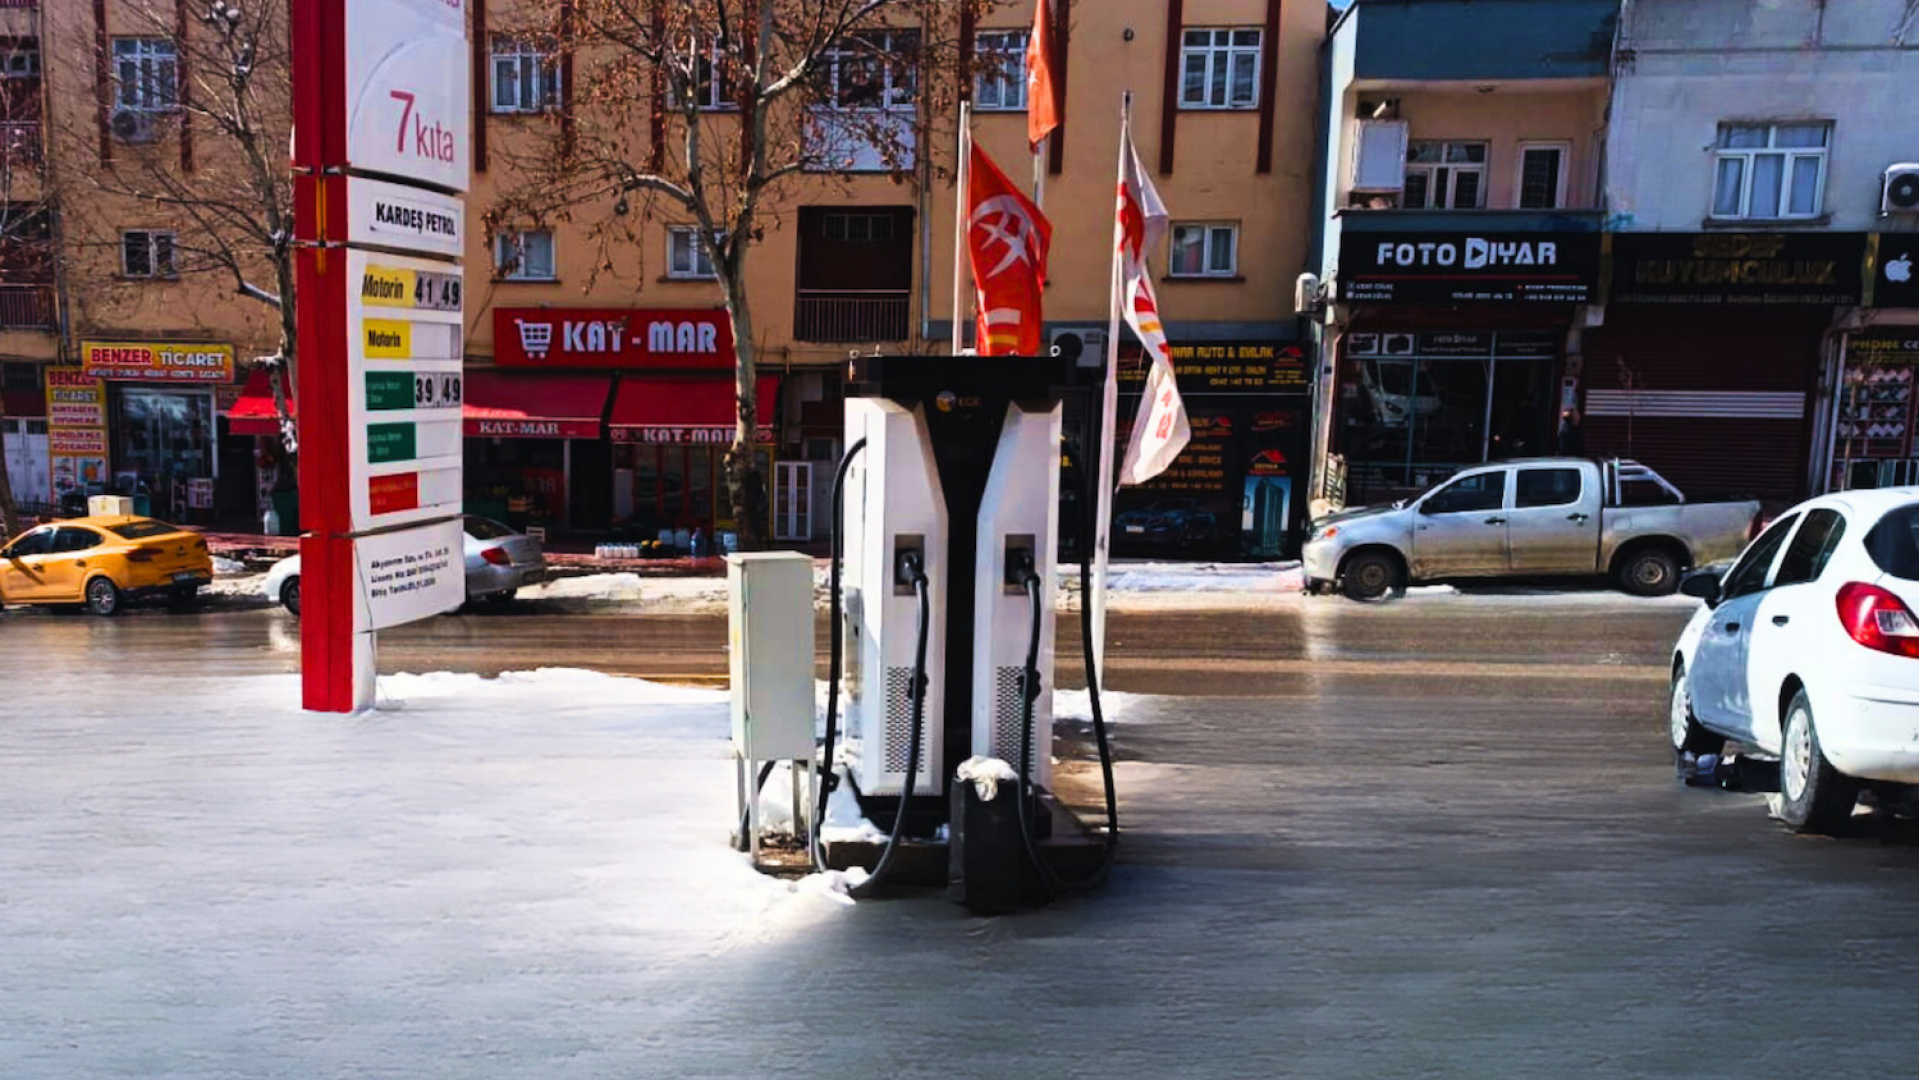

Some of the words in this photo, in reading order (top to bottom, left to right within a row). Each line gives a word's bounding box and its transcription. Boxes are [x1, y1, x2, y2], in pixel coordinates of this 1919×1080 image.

[376, 202, 423, 233] KARDEŞ
[426, 214, 455, 236] PETROL
[1377, 242, 1456, 266] FOTO
[362, 274, 404, 299] Motorin
[368, 329, 401, 348] Motorin
[563, 320, 625, 352] KAT
[648, 321, 717, 353] MAR
[91, 348, 151, 363] BENZER
[159, 348, 225, 366] TİCARET
[479, 422, 560, 435] KAT-MAR
[643, 428, 738, 442] KAT-MAR
